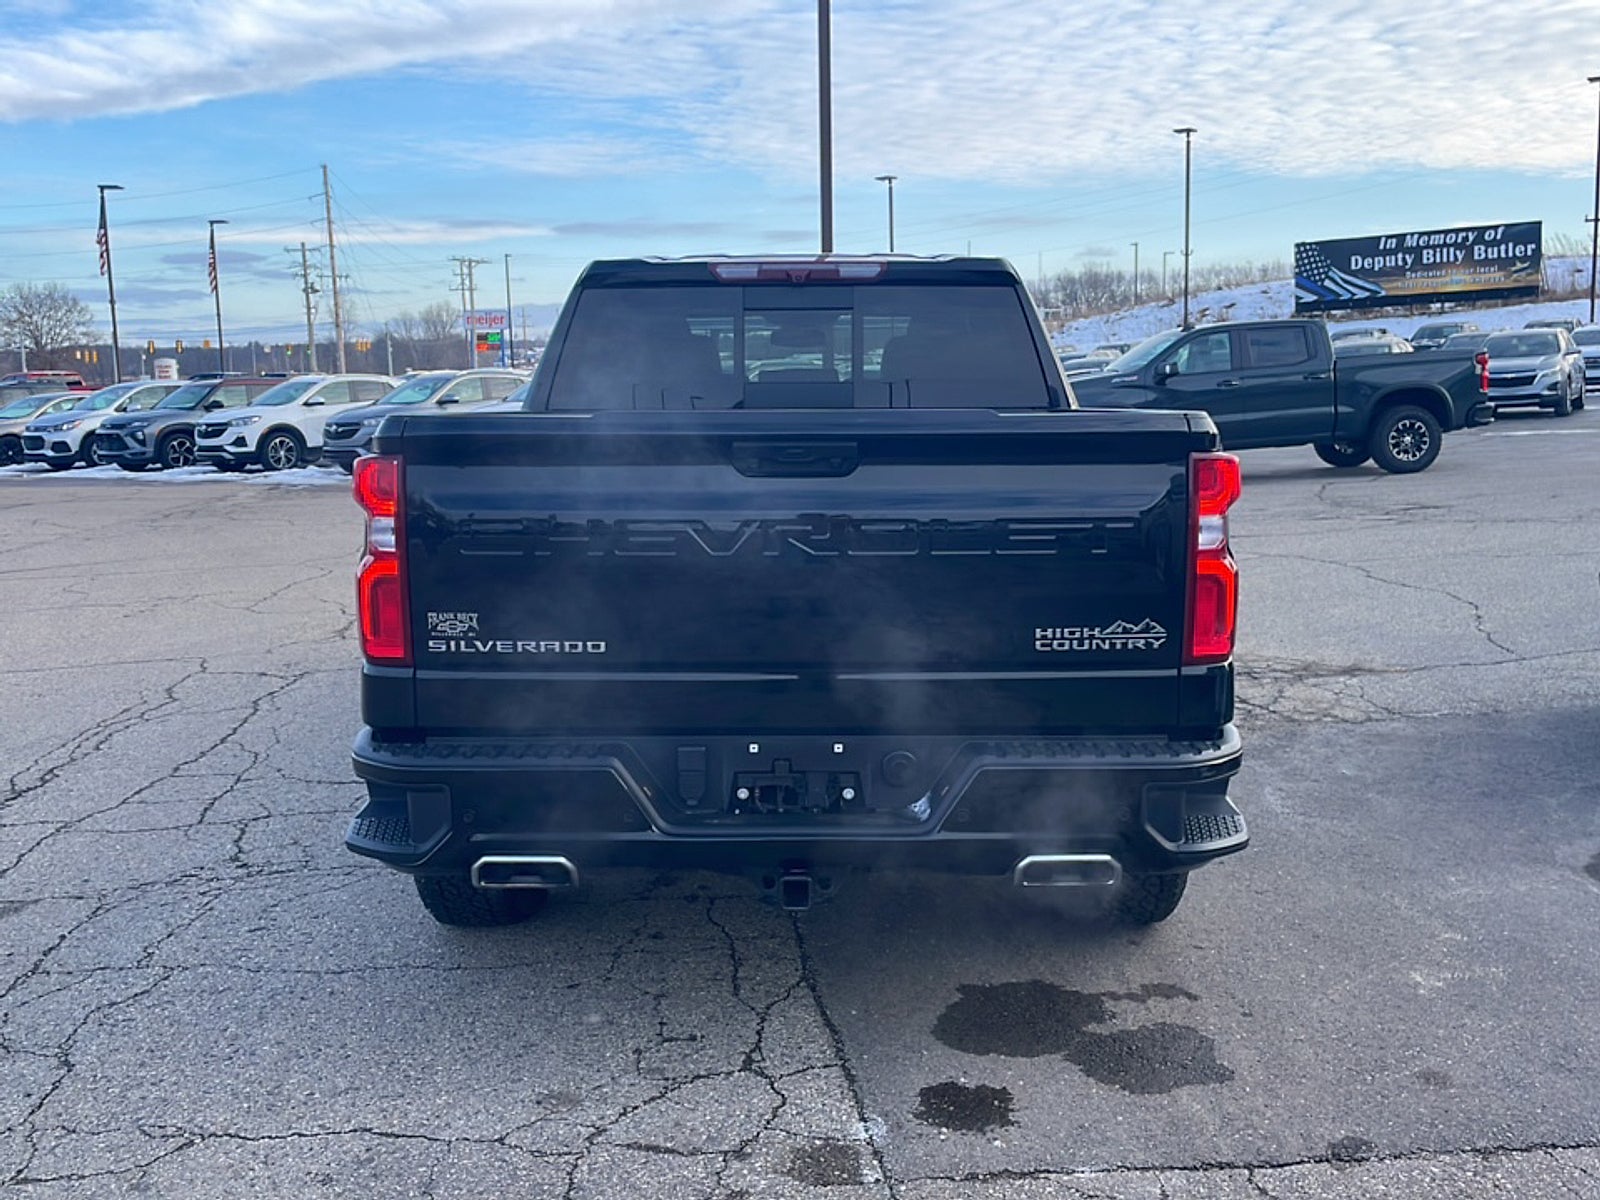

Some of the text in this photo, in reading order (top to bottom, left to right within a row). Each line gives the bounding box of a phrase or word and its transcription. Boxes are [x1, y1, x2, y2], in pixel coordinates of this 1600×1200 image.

[1379, 226, 1505, 250] In Memory of
[1350, 242, 1536, 271] Deputy Billy Butler
[456, 518, 1138, 557] CHEVROLET
[1035, 627, 1101, 639] HIGH
[428, 639, 606, 652] SILVERADO
[1035, 639, 1166, 650] COUNTRY
